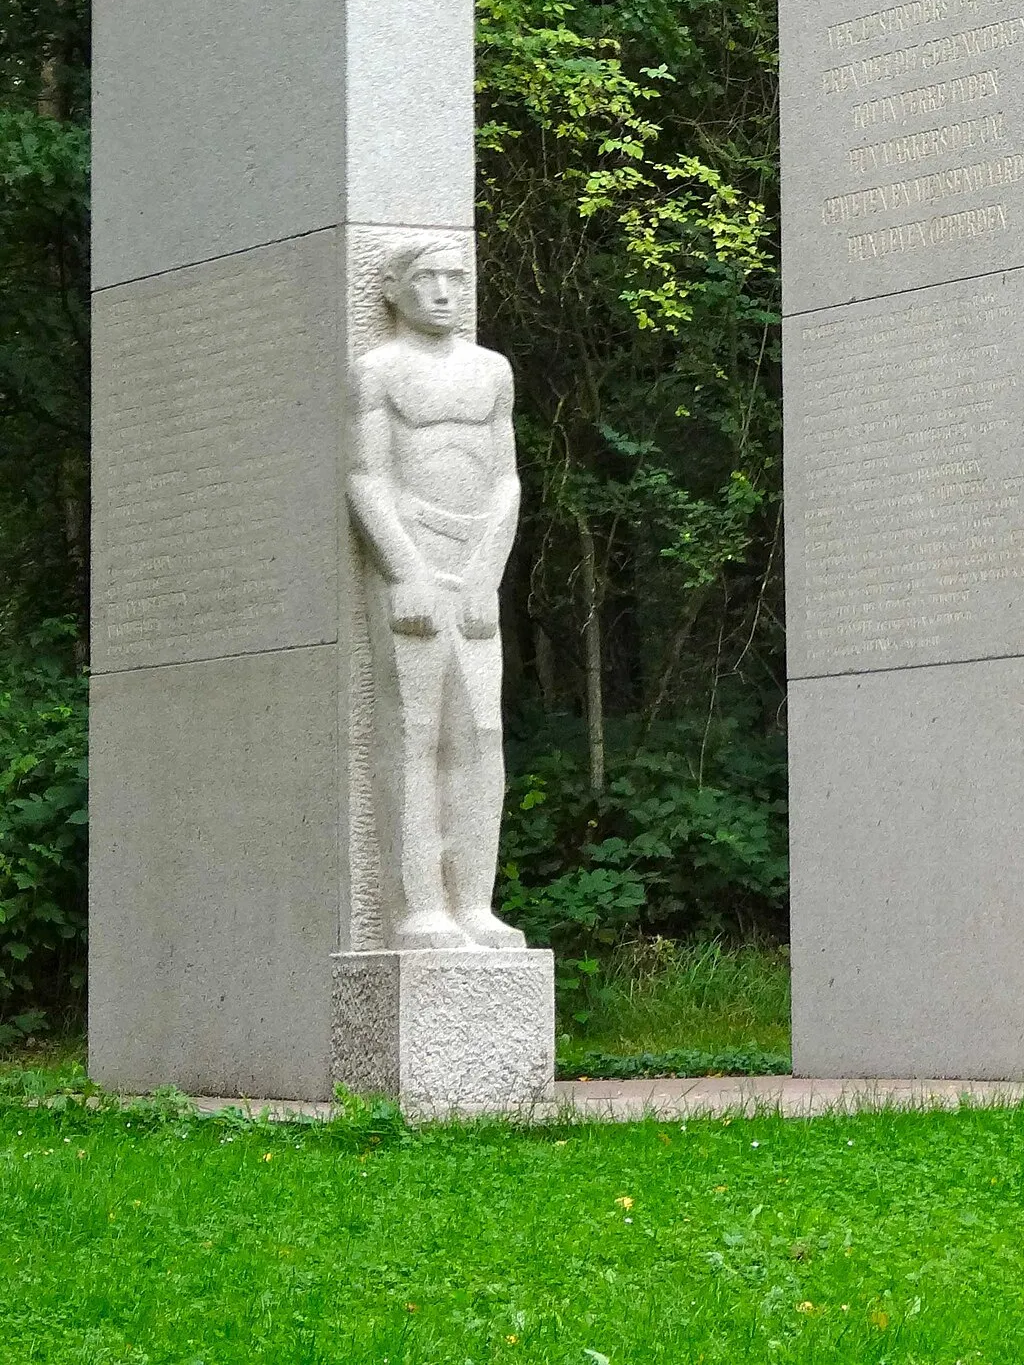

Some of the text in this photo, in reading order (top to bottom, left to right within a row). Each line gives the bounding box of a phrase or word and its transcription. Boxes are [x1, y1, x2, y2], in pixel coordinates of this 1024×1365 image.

[821, 59, 858, 96] EREN
[852, 98, 878, 131] TOT
[881, 93, 896, 124] IN
[899, 81, 946, 120] VERRE
[848, 141, 879, 175] HUN
[882, 125, 948, 168] MAKKERS
[951, 117, 976, 151] DIE
[821, 184, 887, 226] GEWETEN
[891, 179, 910, 210] EN
[847, 201, 1007, 263] HUN LEVEN OFFERDEN
